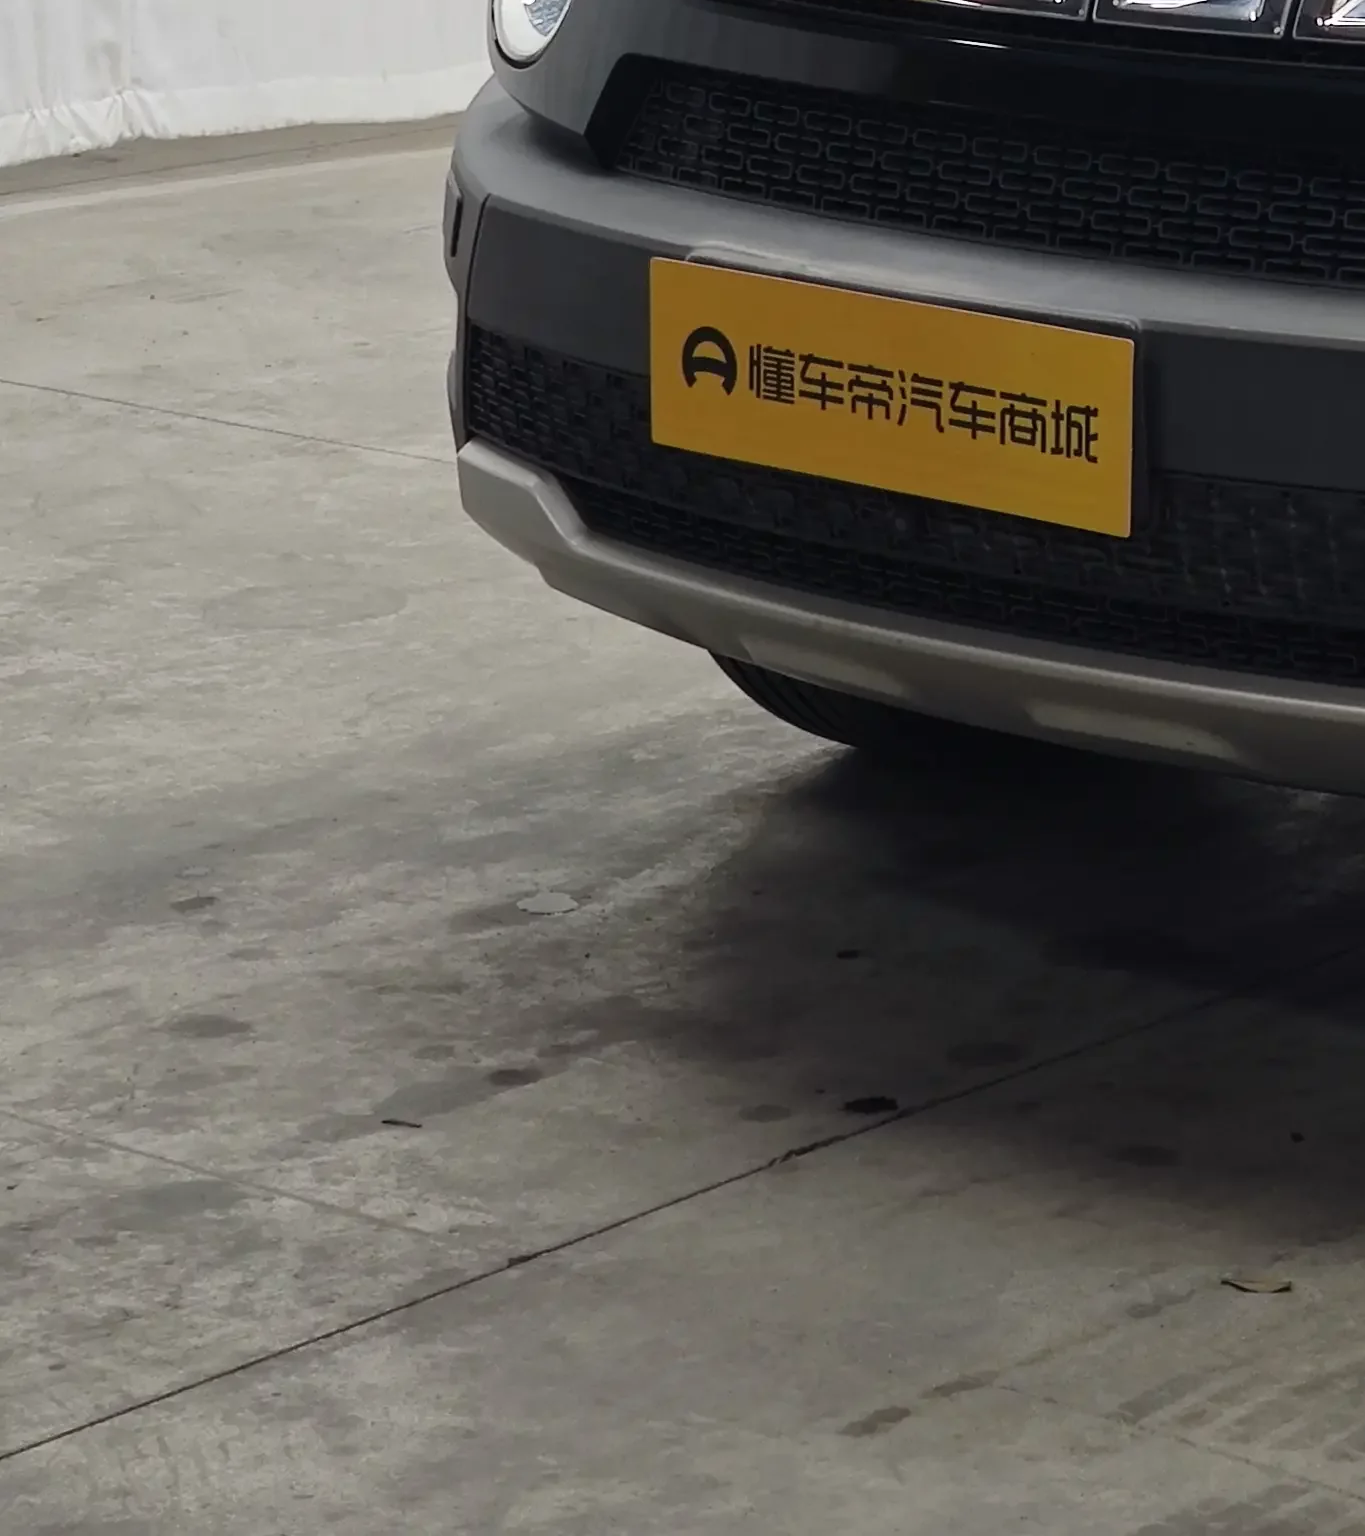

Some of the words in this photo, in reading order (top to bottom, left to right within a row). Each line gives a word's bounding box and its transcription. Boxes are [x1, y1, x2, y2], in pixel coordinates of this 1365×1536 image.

[748, 343, 1098, 464] 懂车帝汽车商城
